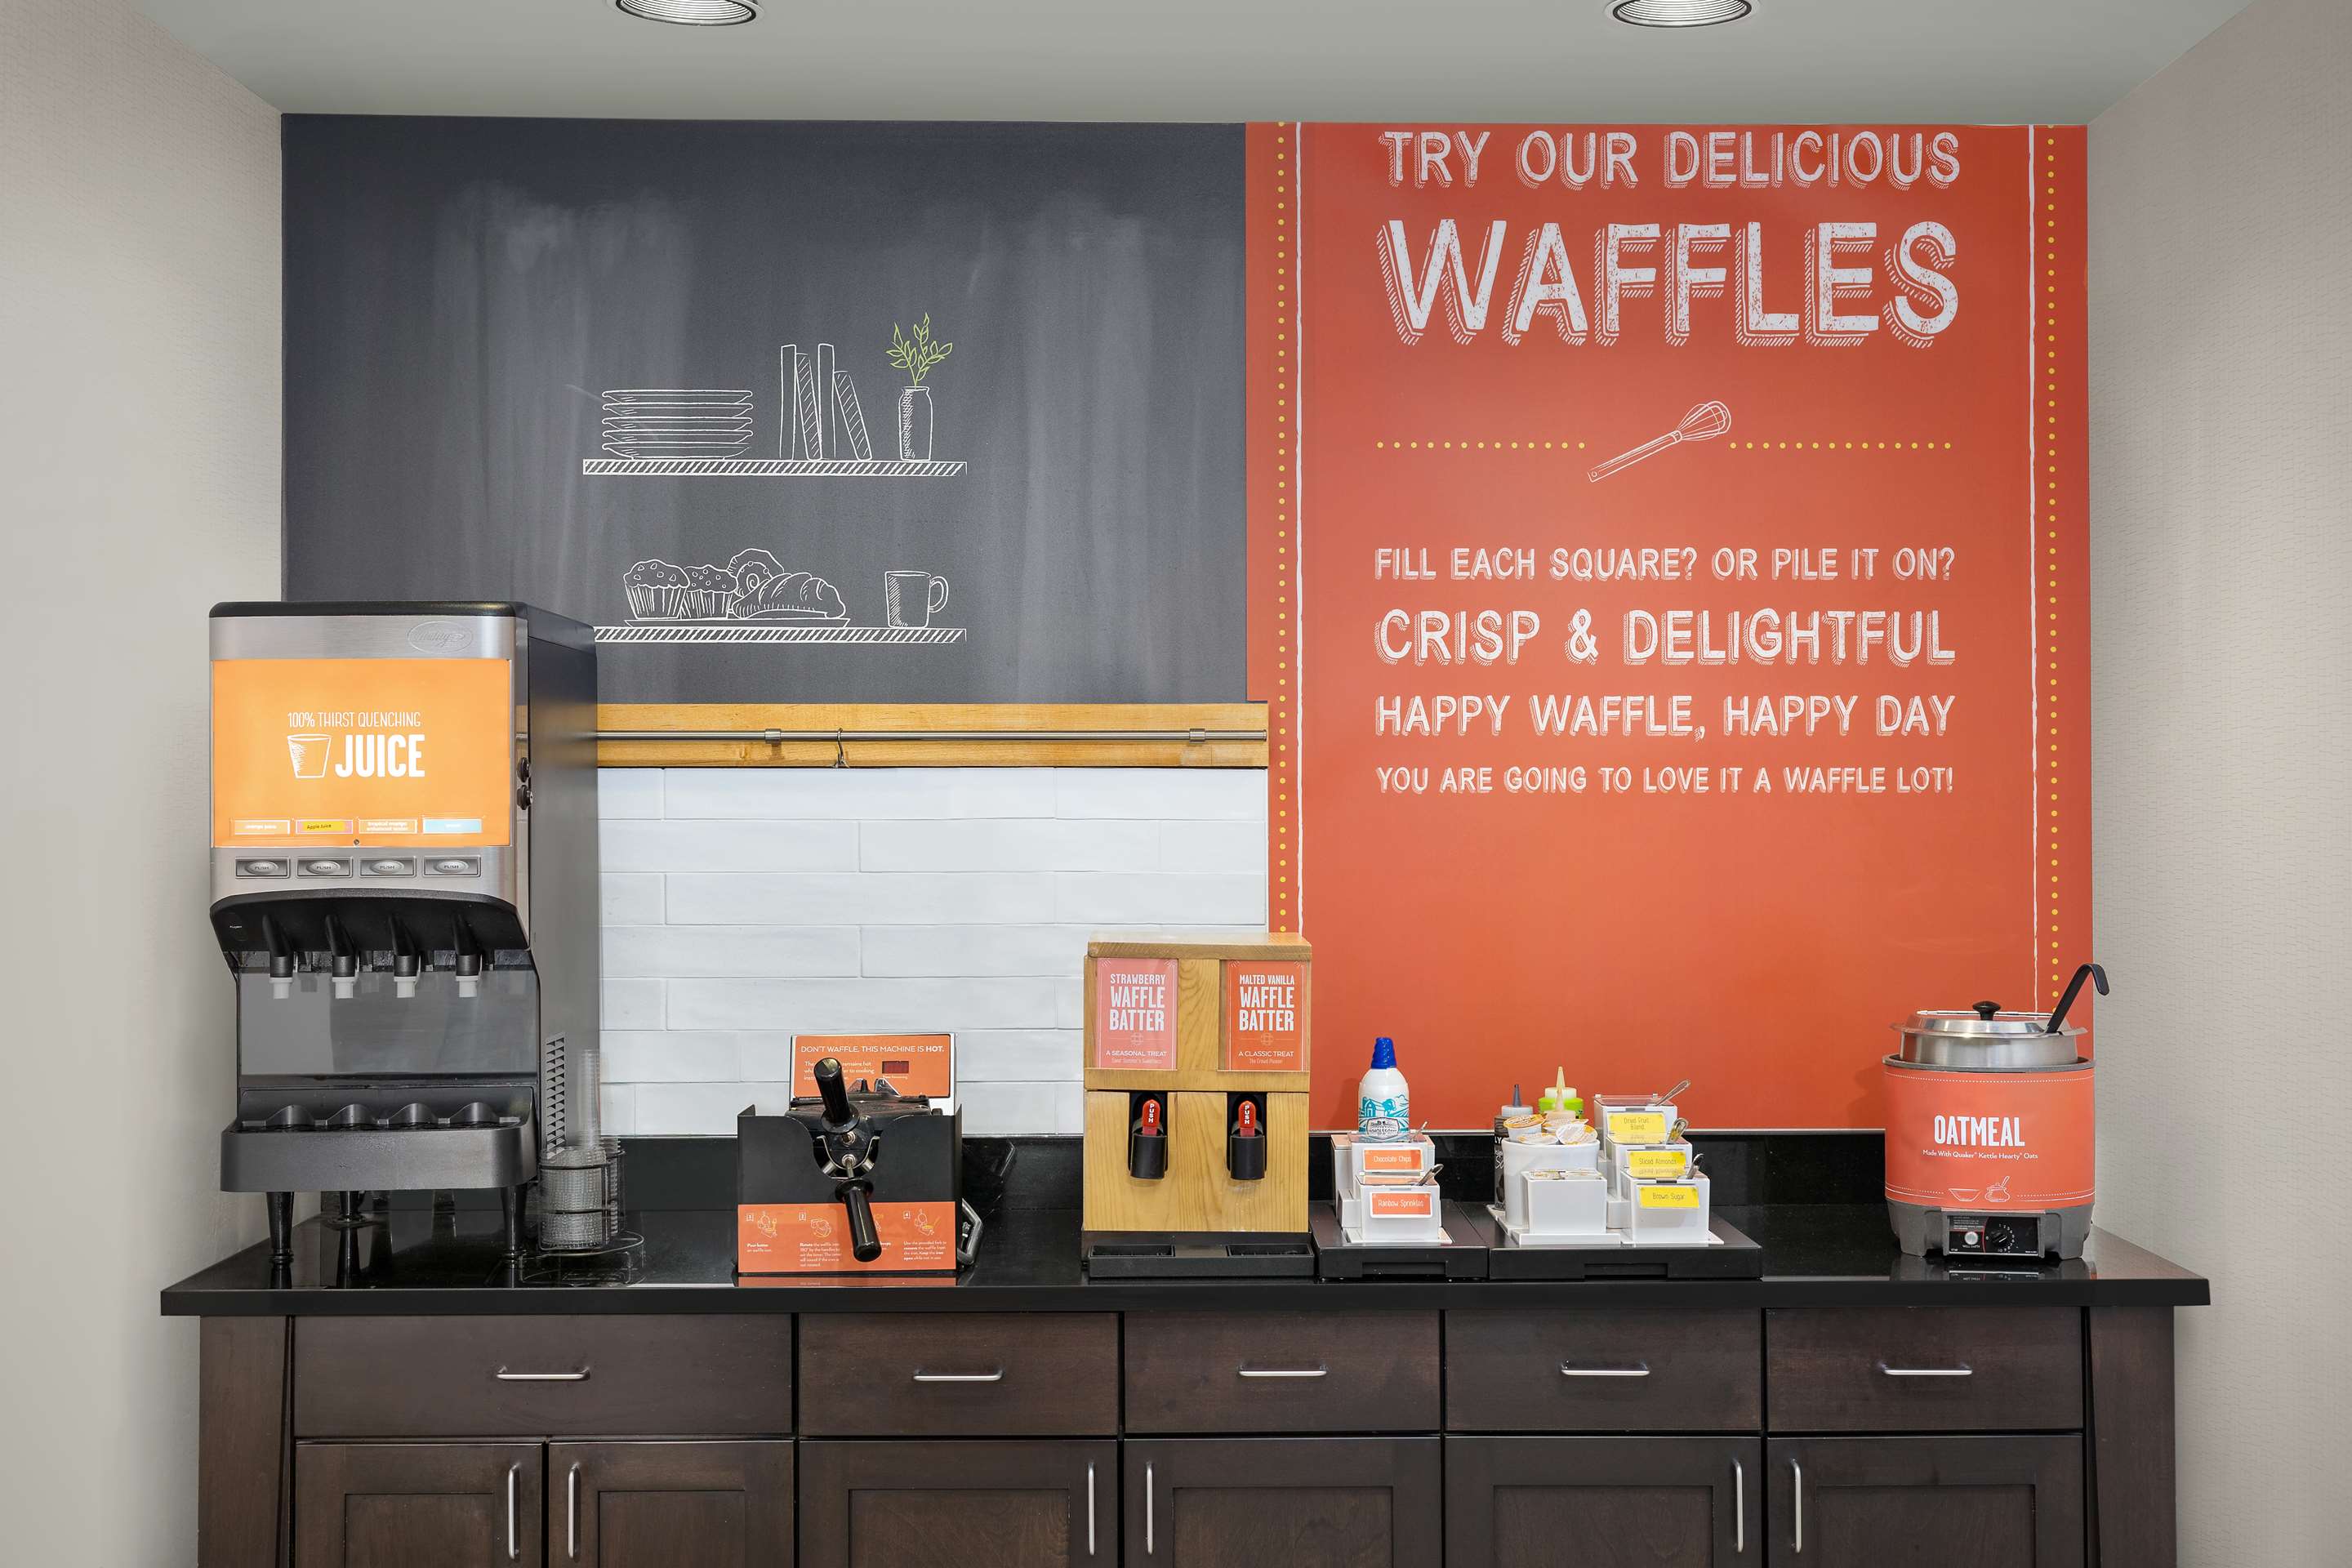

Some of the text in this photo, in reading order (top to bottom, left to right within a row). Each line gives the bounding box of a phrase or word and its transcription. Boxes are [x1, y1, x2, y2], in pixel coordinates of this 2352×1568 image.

[1379, 131, 1960, 191] TRY OUR DELICIOUS
[1376, 218, 1959, 349] WAFFLES
[1375, 546, 1955, 581] FILL EACH SQUARE? OR PILE IT ON?
[1374, 608, 1956, 668] CRISP & DELIGHTFUL
[287, 712, 421, 728] 100% THIRST QUENCHING
[1375, 694, 1956, 742] HAPPY WAFFLE, HAPPY DAY
[335, 734, 425, 778] JUICE
[1375, 765, 1953, 794] YOU ARE GOING TO LOVE IT A WAFFLE LOT!
[1111, 973, 1166, 985] STRAWBERRY
[1239, 974, 1294, 985] MALTED VANILLA
[1111, 986, 1165, 1009] WAFFLE
[1240, 986, 1294, 1009] WAFFLE
[1109, 1009, 1165, 1031] BATTER
[1239, 1009, 1294, 1031] BATTER
[1934, 1115, 2026, 1147] OATMEAL
[1671, 1192, 1686, 1201] Sugar
